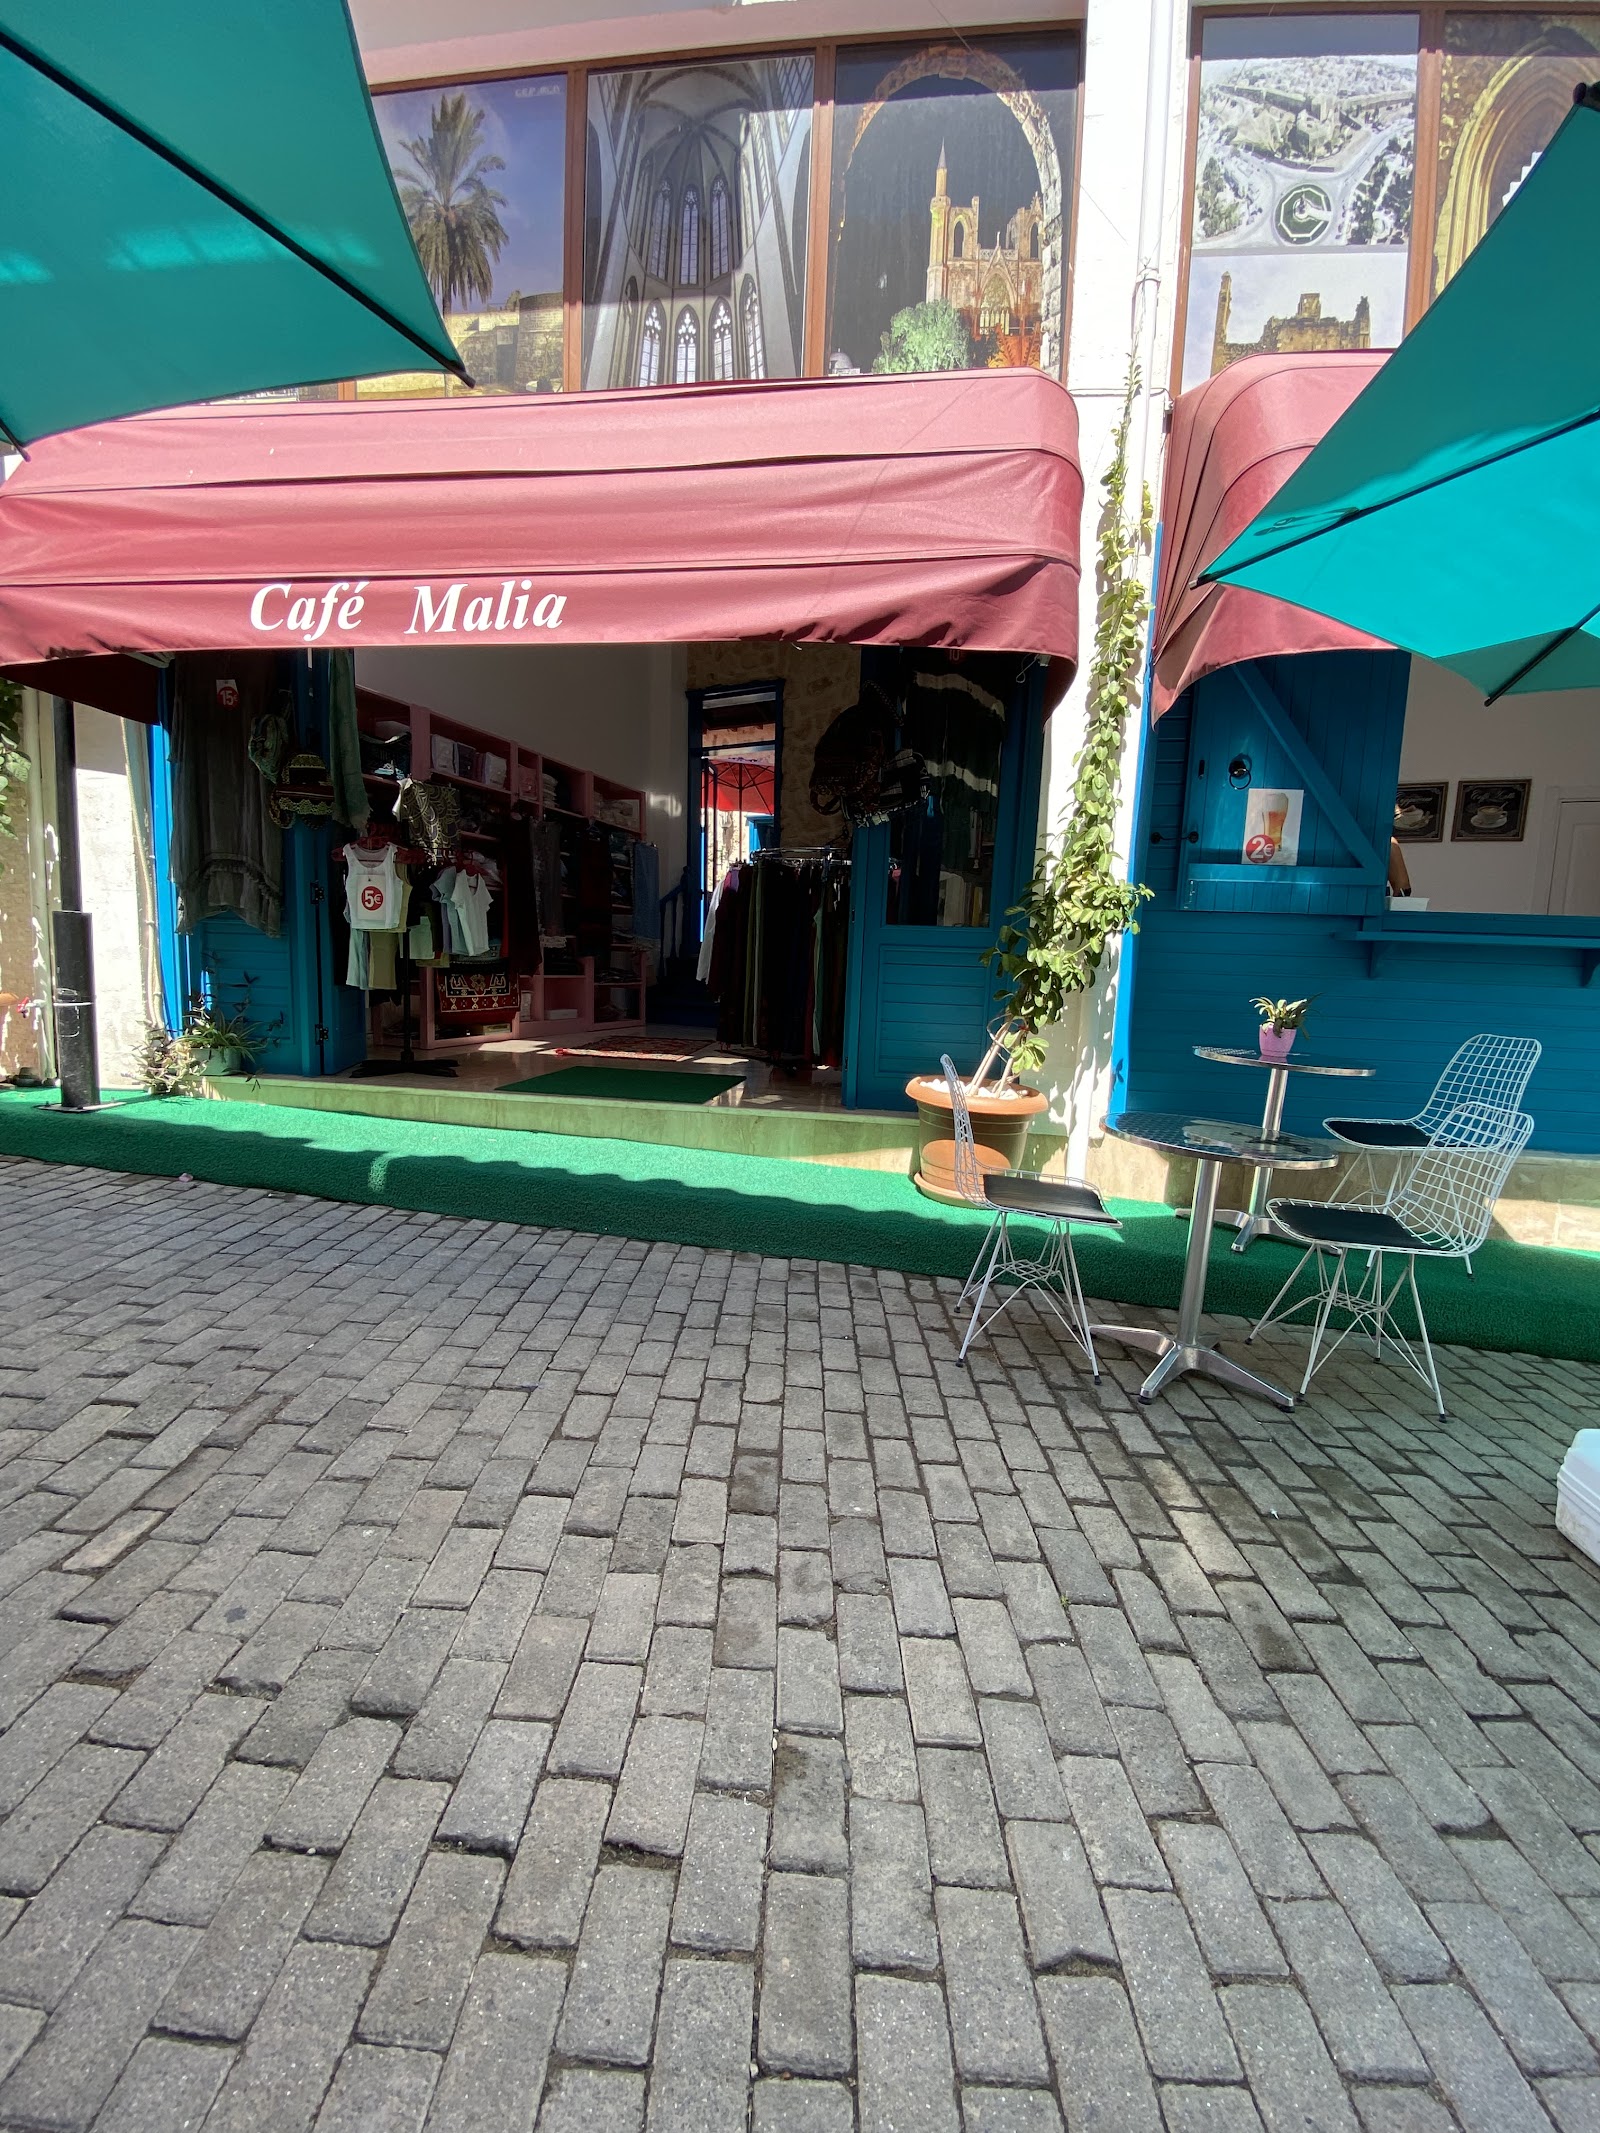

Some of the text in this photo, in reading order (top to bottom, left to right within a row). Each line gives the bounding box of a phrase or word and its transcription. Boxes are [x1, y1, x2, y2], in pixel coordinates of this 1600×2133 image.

[250, 579, 567, 642] Café Malia
[1250, 836, 1274, 859] 2€
[364, 889, 382, 908] 5€
